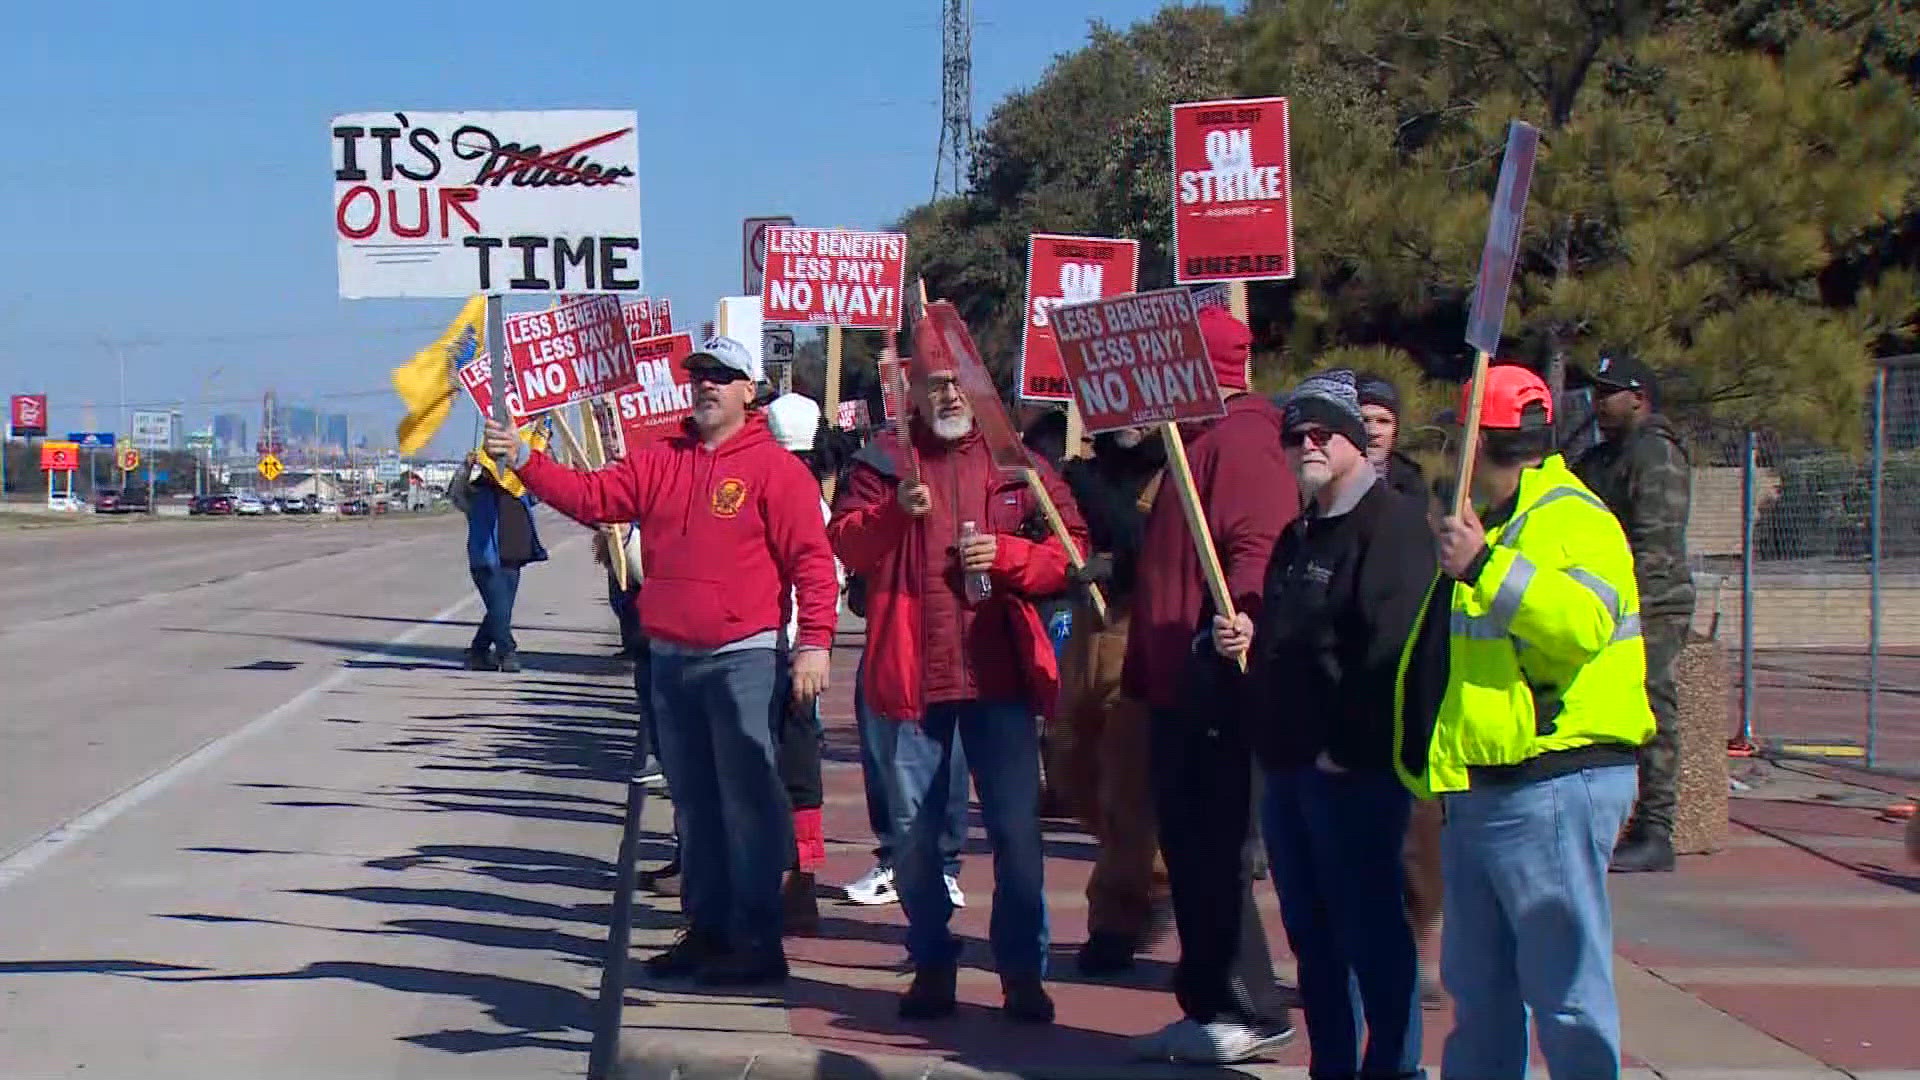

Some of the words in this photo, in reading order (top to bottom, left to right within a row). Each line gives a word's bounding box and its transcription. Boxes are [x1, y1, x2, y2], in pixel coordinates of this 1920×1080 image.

[333, 112, 442, 182] IT'S
[1205, 128, 1251, 163] ON
[1179, 166, 1282, 204] STRIKE
[336, 184, 480, 239] OUR
[463, 235, 640, 291] TIME
[770, 229, 813, 253] LESS
[816, 233, 900, 259] BENEFITS
[1186, 255, 1283, 275] UNFAIR
[783, 256, 831, 280] LESS
[836, 260, 885, 285] PAY?
[769, 279, 813, 311] NO
[821, 284, 895, 317] WAY!
[1053, 307, 1103, 341] LESS
[1103, 293, 1191, 334] BENEFITS
[509, 314, 552, 345] LESS
[555, 297, 620, 332] BENEFITS
[528, 334, 577, 366] LESS
[578, 324, 614, 355] PAY?
[1079, 337, 1136, 373] LESS
[1138, 330, 1185, 363] PAY?
[523, 362, 567, 401] NO
[571, 344, 630, 388] WAY!
[635, 357, 674, 390] ON
[1077, 372, 1130, 417] NO
[1131, 359, 1212, 405] WAY!
